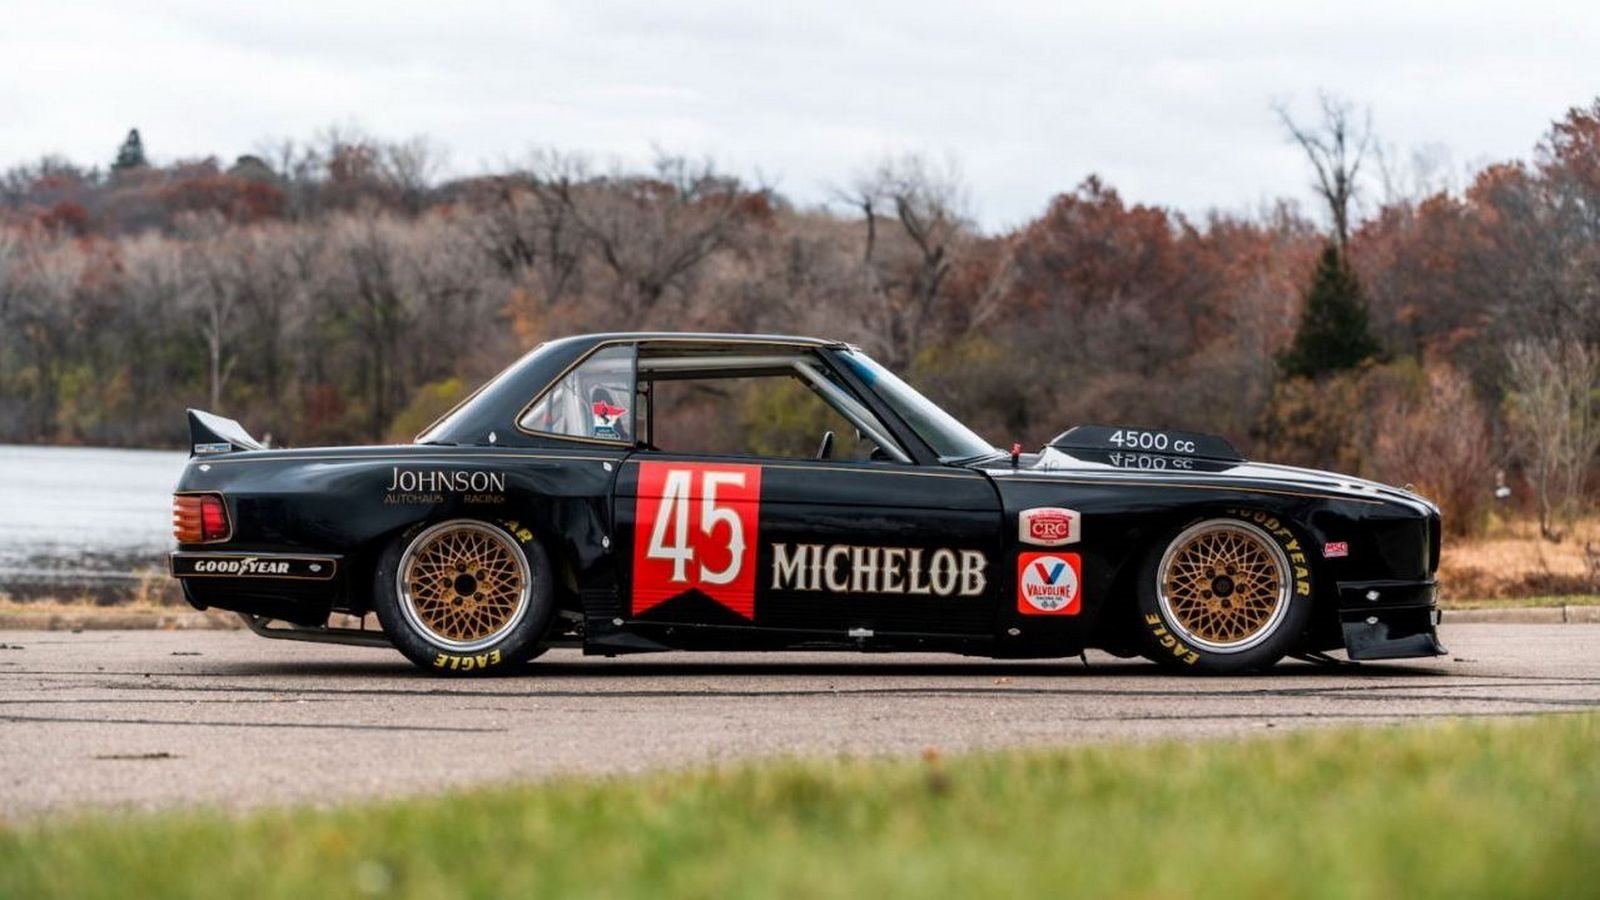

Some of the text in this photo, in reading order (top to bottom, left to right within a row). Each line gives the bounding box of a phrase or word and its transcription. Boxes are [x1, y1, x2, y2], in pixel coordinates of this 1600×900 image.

[1109, 430, 1168, 450] 4500
[387, 467, 505, 492] JOHNSON
[646, 469, 746, 585] 45
[1032, 522, 1067, 536] CRC
[771, 542, 989, 596] MICHELOB
[1027, 583, 1071, 598] VALVOLINE
[1145, 613, 1200, 666] EAGLE
[434, 649, 501, 671] EAGLE
